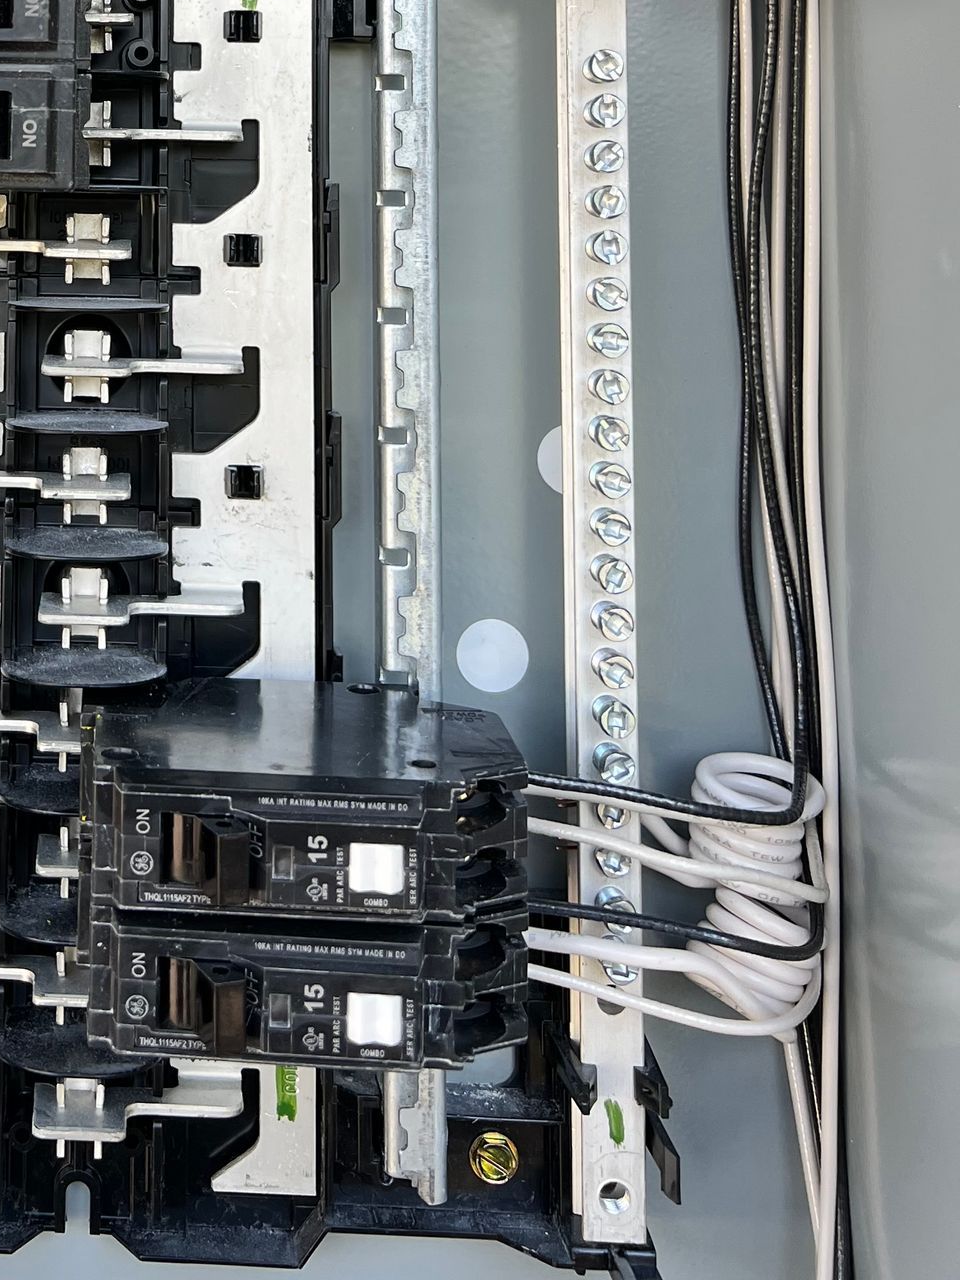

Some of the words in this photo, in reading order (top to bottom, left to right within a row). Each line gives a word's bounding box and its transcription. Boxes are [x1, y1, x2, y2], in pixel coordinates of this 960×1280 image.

[22, 119, 38, 147] ON
[290, 798, 315, 807] RATING
[367, 801, 386, 811] MADE
[135, 808, 151, 834] ON
[307, 835, 328, 863] 15
[336, 847, 344, 866] TEST
[409, 848, 417, 868] TEST
[751, 851, 784, 862] TEW
[336, 870, 344, 888] ARC
[409, 871, 417, 888] ARC
[336, 889, 344, 903] PAR
[363, 897, 388, 907] COMBO
[409, 889, 417, 904] SER
[286, 943, 312, 953] RATING
[365, 948, 384, 958] MADE
[131, 952, 146, 978] ON
[304, 984, 325, 1012] 15
[406, 999, 414, 1018] TEST
[360, 1048, 385, 1058] COMBO
